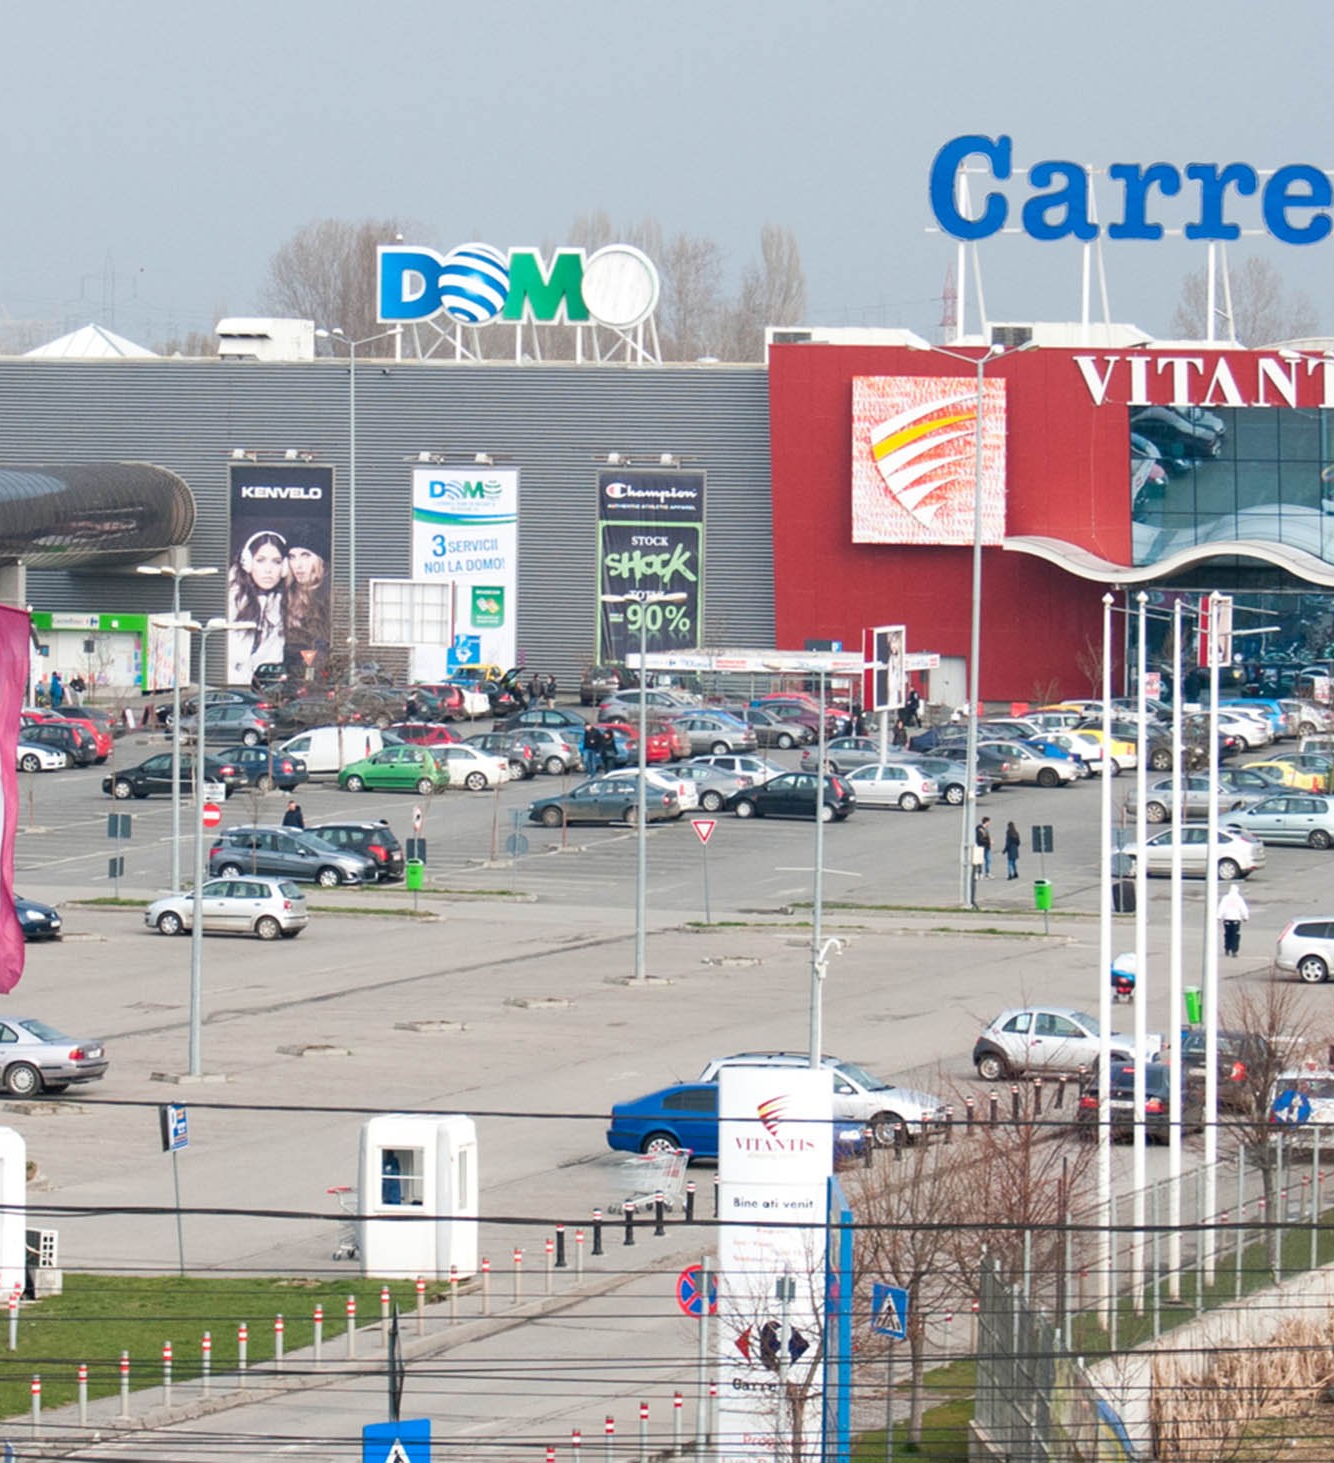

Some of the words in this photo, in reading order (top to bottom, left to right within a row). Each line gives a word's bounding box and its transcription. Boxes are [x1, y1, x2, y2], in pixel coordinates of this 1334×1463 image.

[376, 242, 660, 328] DOMO
[241, 486, 322, 499] KENVELO
[429, 480, 503, 500] DOMO
[606, 483, 698, 503] Champion
[432, 534, 447, 557] 3
[448, 538, 498, 554] SERVICII
[630, 535, 669, 546] STOCK
[424, 560, 445, 574] NOI
[448, 560, 463, 573] LA
[735, 1137, 815, 1152] VITANTIS
[733, 1197, 759, 1209] Bine
[782, 1199, 814, 1209] venit
